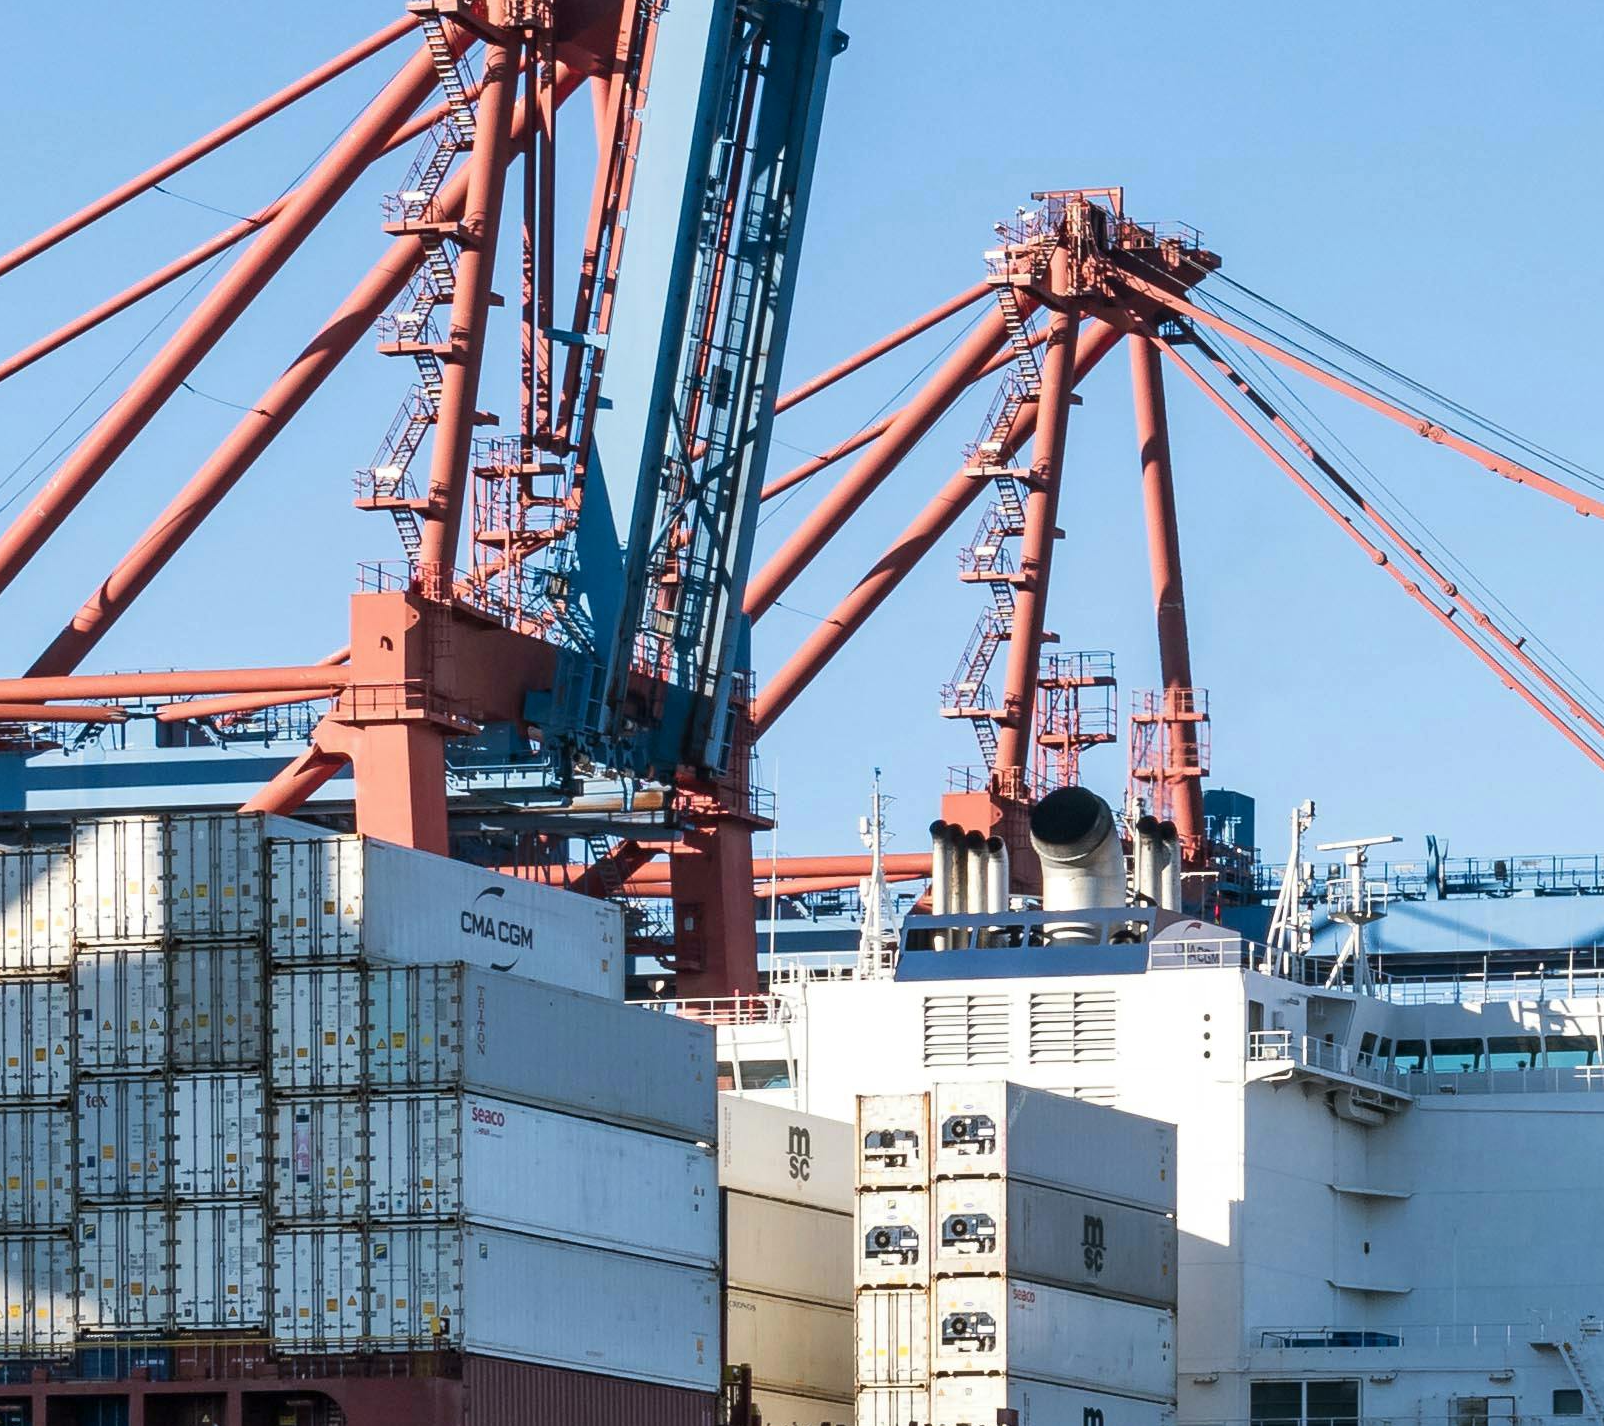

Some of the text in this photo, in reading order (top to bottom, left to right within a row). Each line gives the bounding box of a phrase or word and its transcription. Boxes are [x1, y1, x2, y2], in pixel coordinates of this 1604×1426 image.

[460, 911, 533, 950] CMA CGM
[476, 985, 486, 1056] TRITON
[85, 1093, 108, 1108] tex
[471, 1106, 505, 1127] seaco
